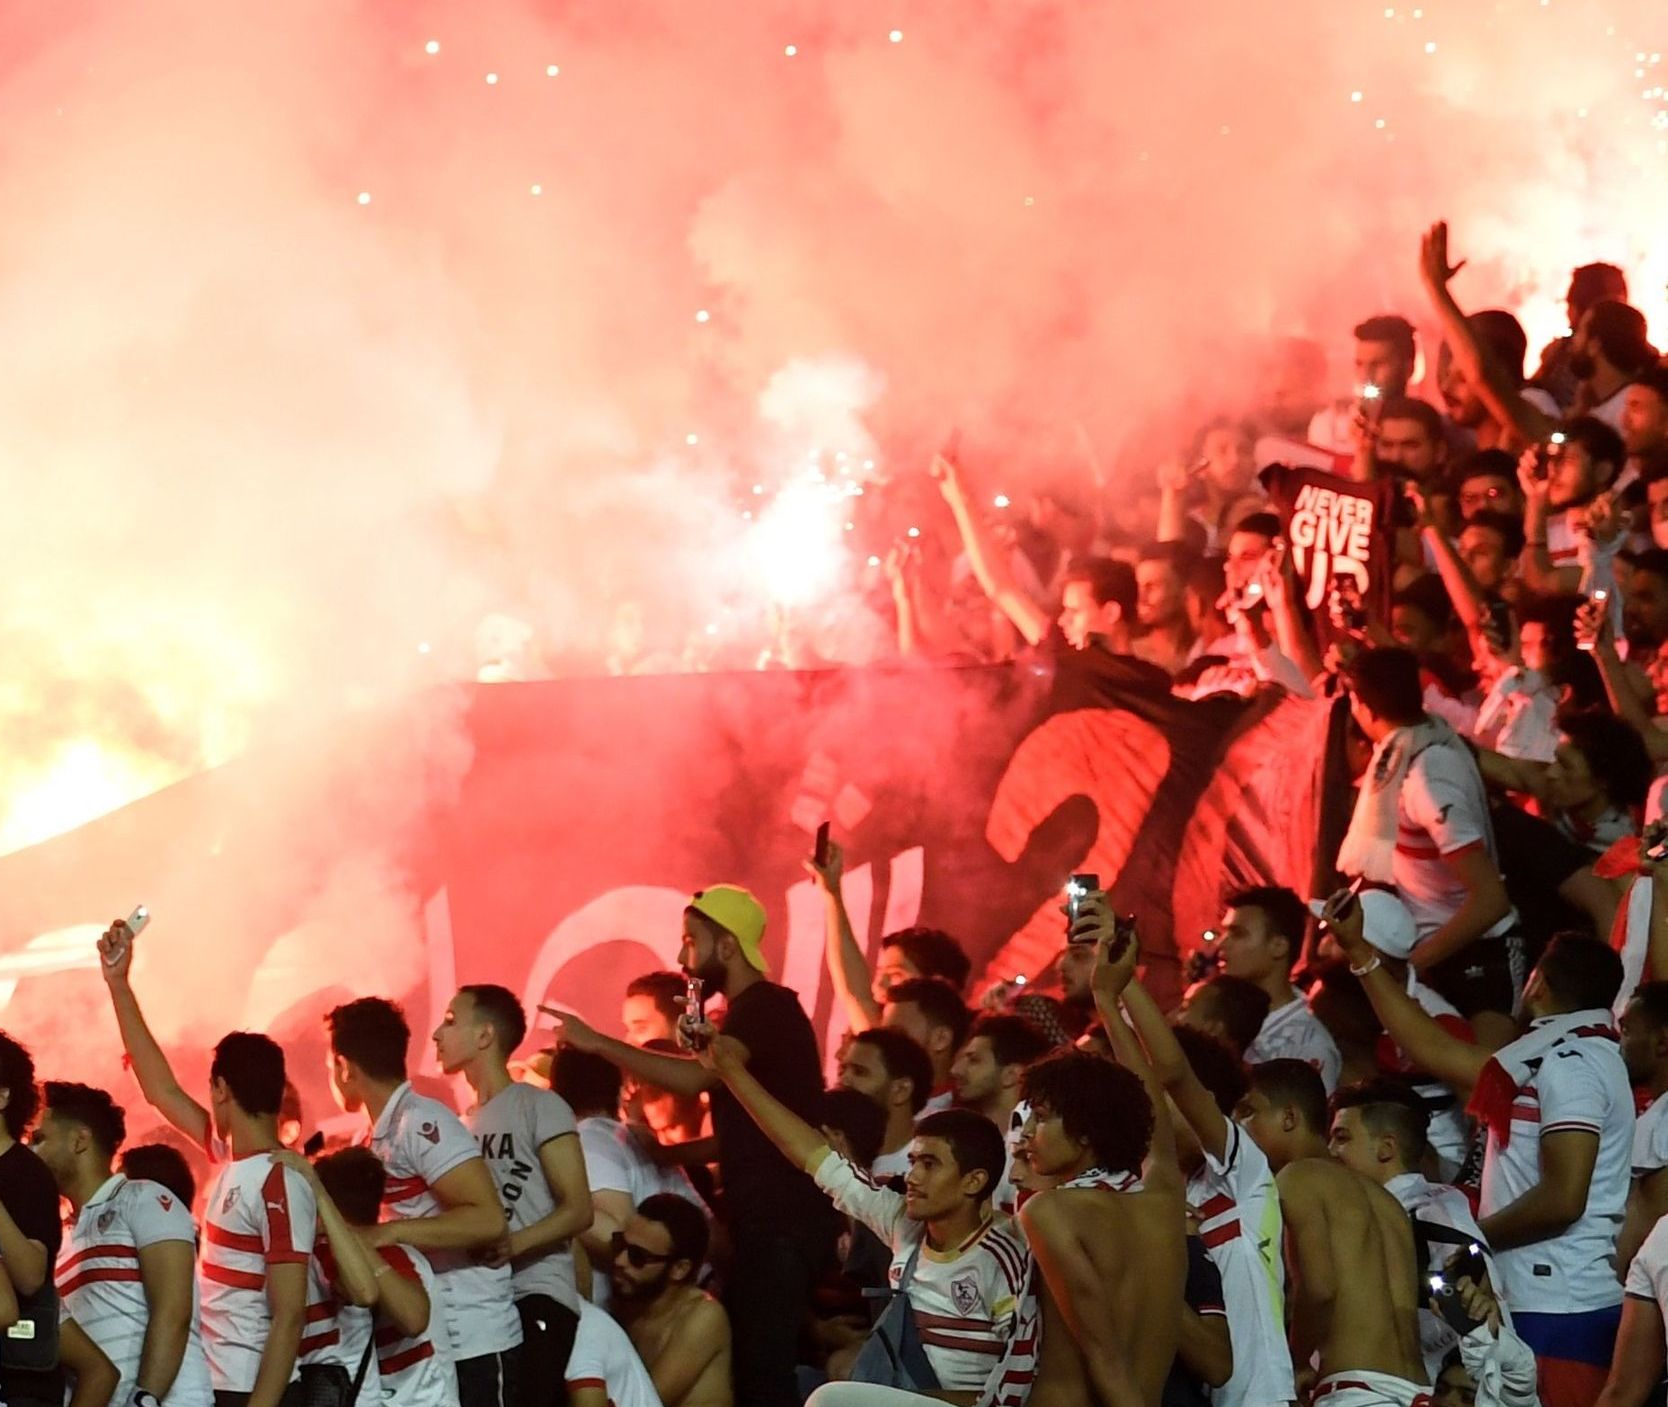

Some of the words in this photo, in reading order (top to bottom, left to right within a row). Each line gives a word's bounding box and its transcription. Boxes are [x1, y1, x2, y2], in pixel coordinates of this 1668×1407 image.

[1295, 484, 1373, 524] NEVER
[1290, 512, 1371, 562] GIVE
[475, 1133, 515, 1159] KA
